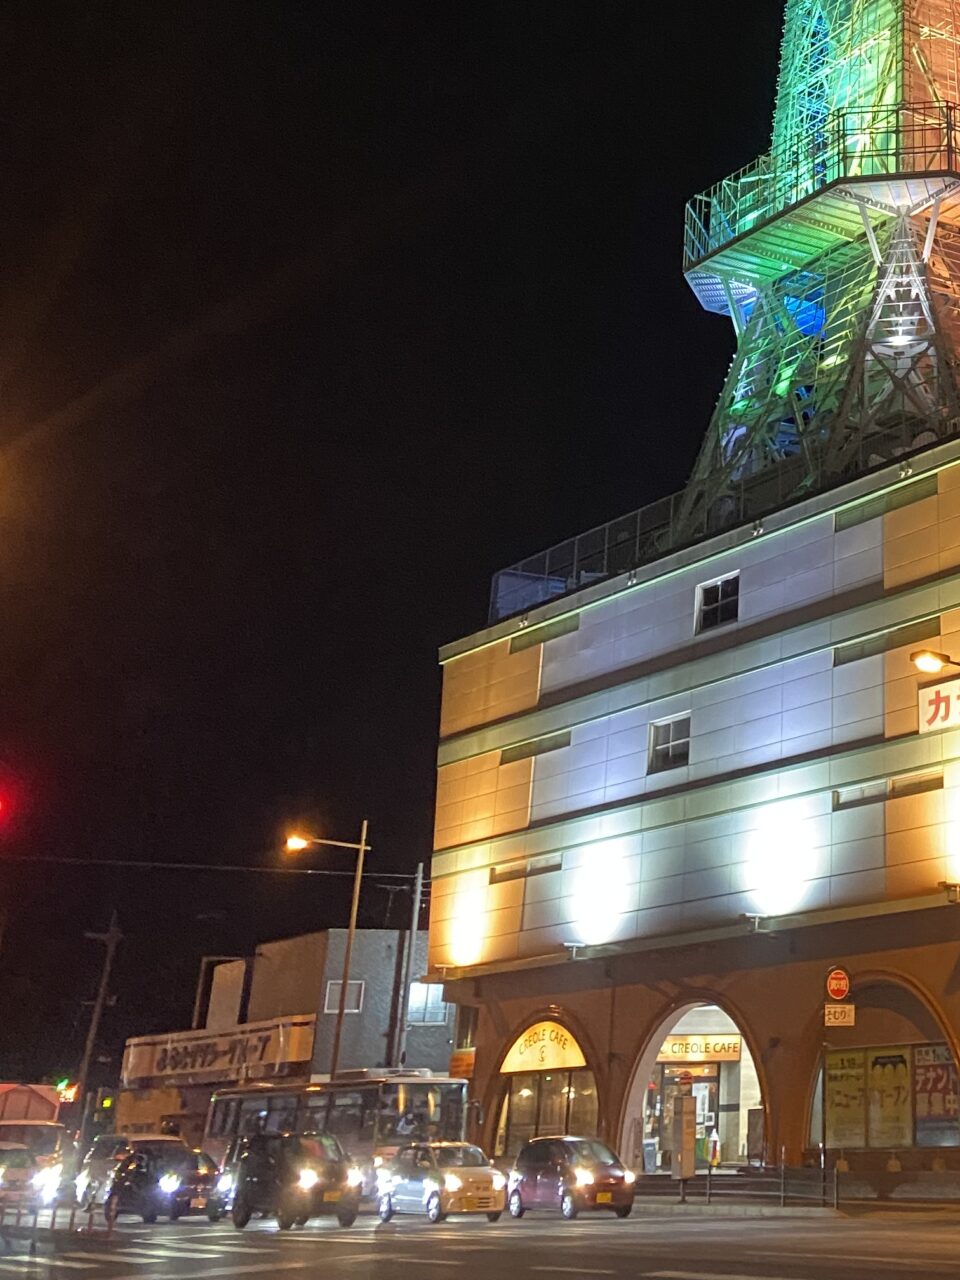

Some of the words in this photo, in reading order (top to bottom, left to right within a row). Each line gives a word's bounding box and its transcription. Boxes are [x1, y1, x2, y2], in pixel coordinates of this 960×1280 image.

[519, 1029, 546, 1055] CREOLE
[549, 1030, 568, 1051] CAFE
[671, 1042, 710, 1054] CREOLE
[713, 1042, 739, 1053] CAFE
[915, 1067, 958, 1091] テナント
